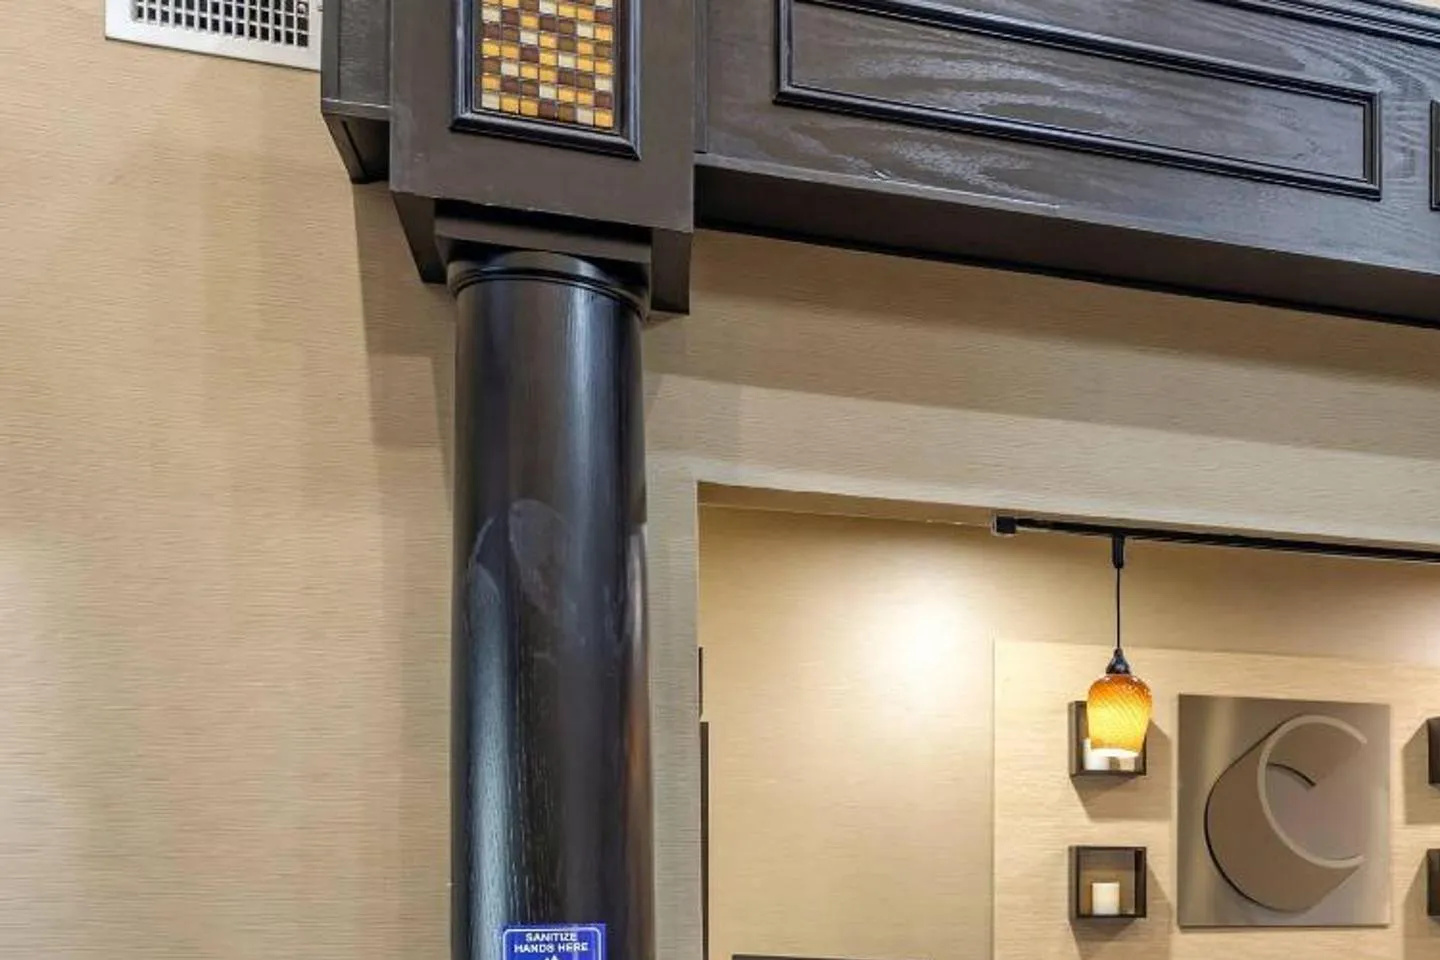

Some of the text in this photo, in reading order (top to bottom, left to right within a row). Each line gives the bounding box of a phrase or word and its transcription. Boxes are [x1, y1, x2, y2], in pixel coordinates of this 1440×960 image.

[525, 932, 578, 942] SANITIZE
[514, 942, 589, 953] HANDS HERE
